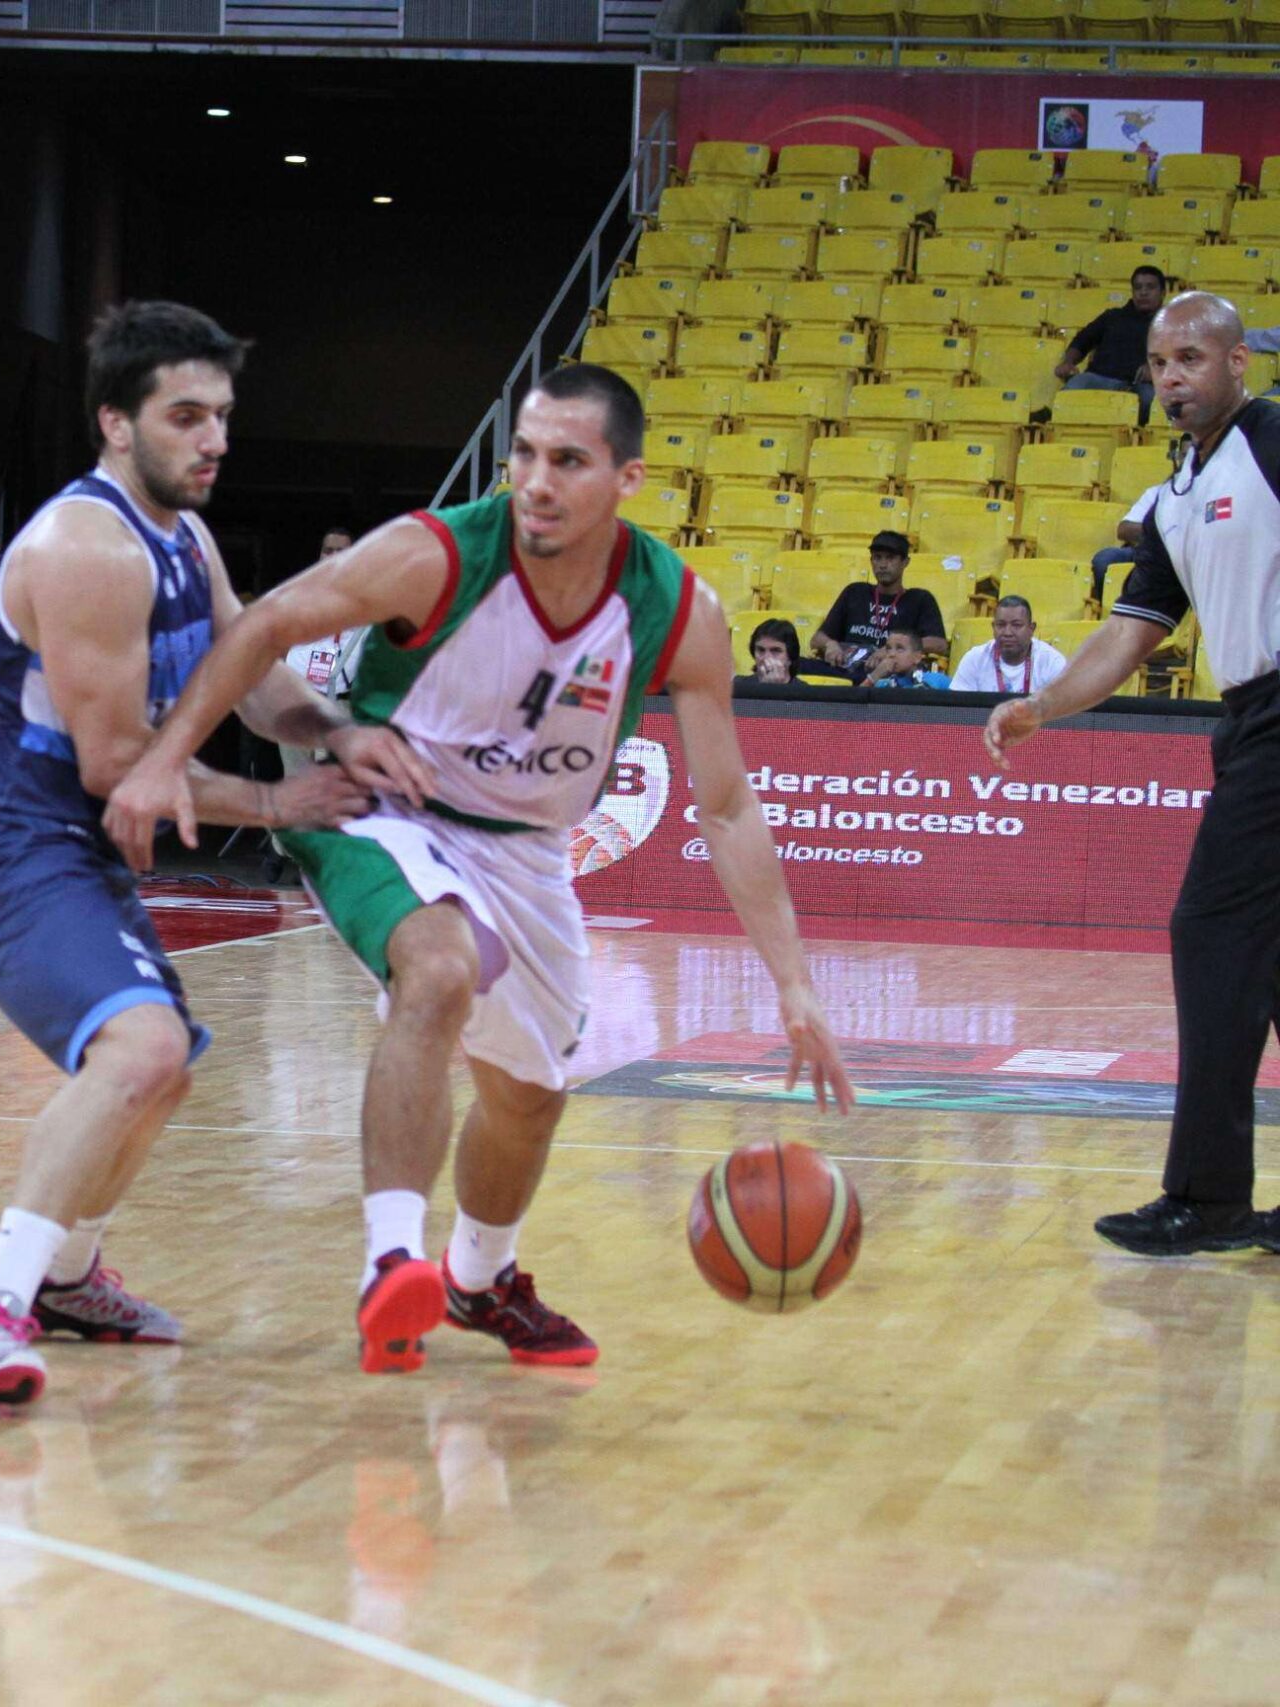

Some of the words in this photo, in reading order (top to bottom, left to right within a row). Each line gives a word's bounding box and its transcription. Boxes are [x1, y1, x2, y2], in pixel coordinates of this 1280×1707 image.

[517, 669, 556, 731] 4
[687, 765, 952, 798] deración
[761, 802, 1025, 837] Baloncesto
